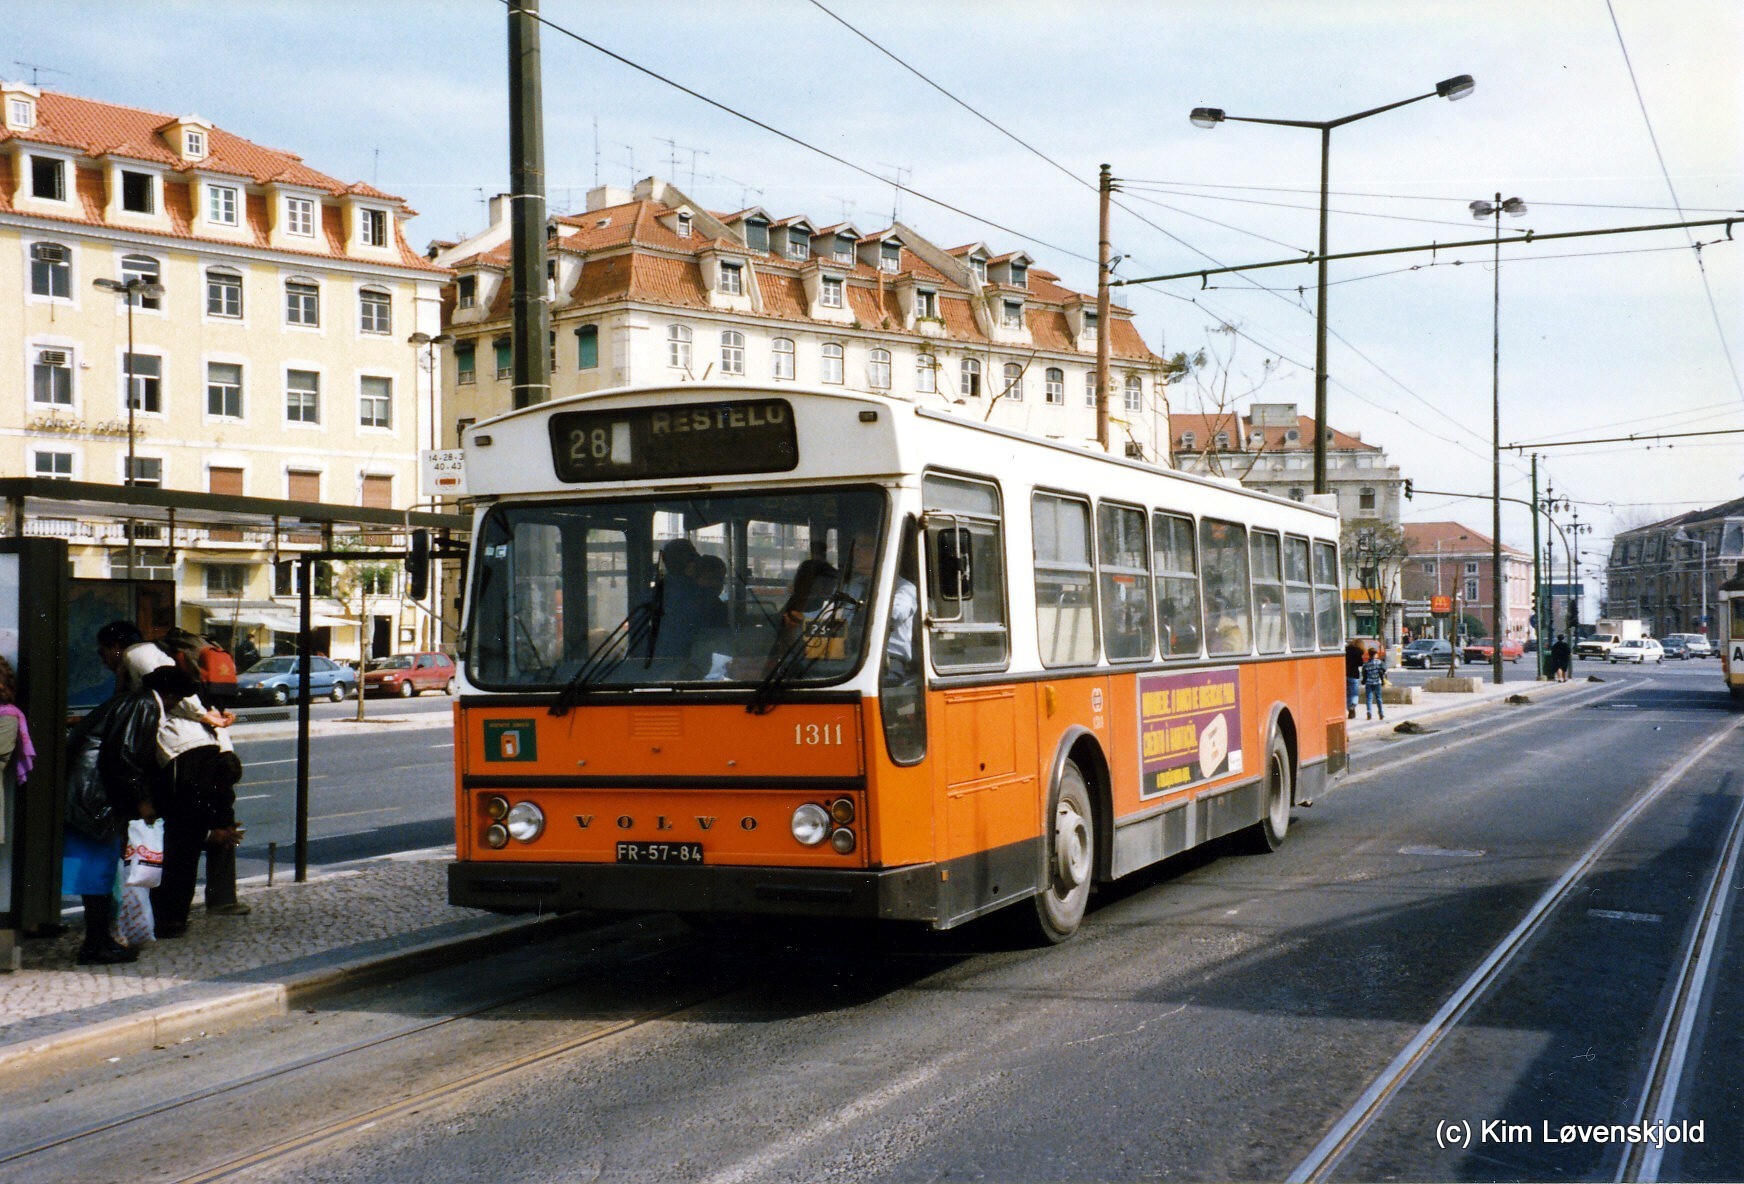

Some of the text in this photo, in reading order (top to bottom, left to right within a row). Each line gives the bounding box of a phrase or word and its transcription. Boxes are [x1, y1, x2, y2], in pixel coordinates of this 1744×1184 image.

[570, 428, 607, 460] 28
[795, 723, 842, 745] 1311
[575, 815, 758, 831] VOLVO
[617, 844, 702, 862] FR-57-84
